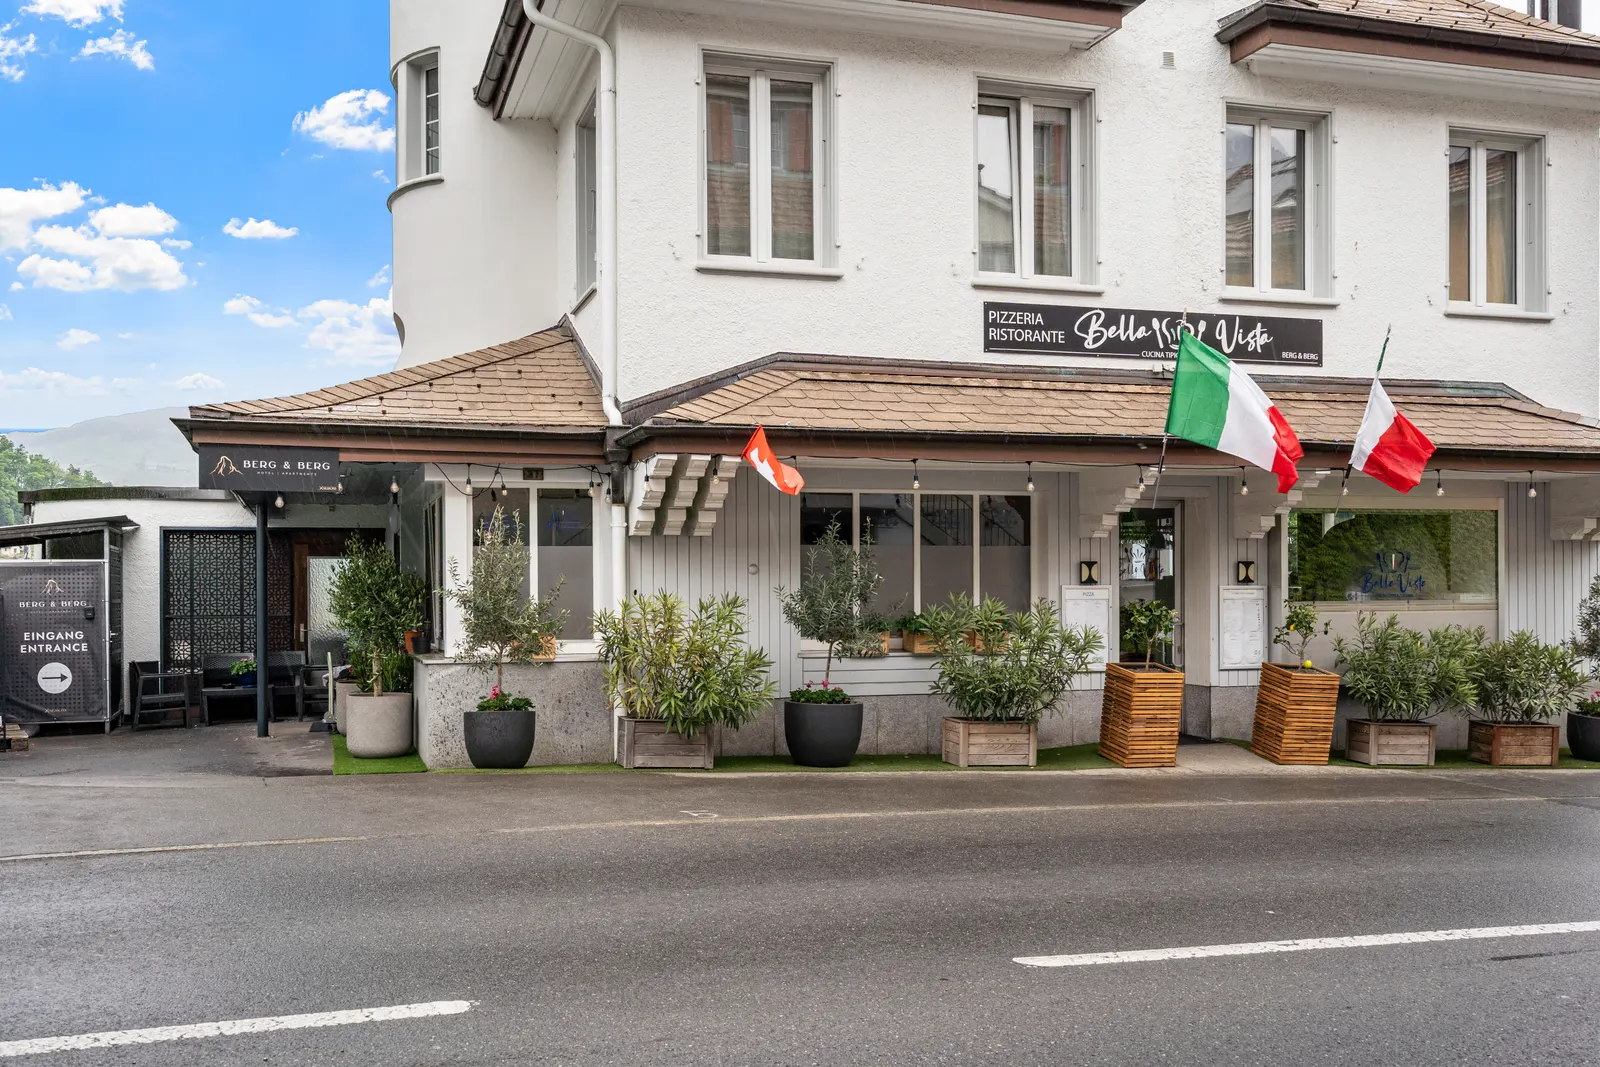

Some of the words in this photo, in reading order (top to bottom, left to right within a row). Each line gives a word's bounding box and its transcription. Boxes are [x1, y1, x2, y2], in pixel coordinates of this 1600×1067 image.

[988, 310, 1044, 326] PIZZERIA
[988, 327, 1066, 344] RISTORANTE
[1074, 309, 1152, 349] Bella
[1215, 316, 1274, 354] Vista
[1141, 350, 1165, 358] CUCINA
[1282, 351, 1297, 359] BERG
[243, 460, 277, 469] BERG
[283, 461, 291, 470] &
[297, 462, 331, 470] BERG
[23, 631, 84, 641] EINGANG
[20, 643, 88, 653] ENTRANCE
